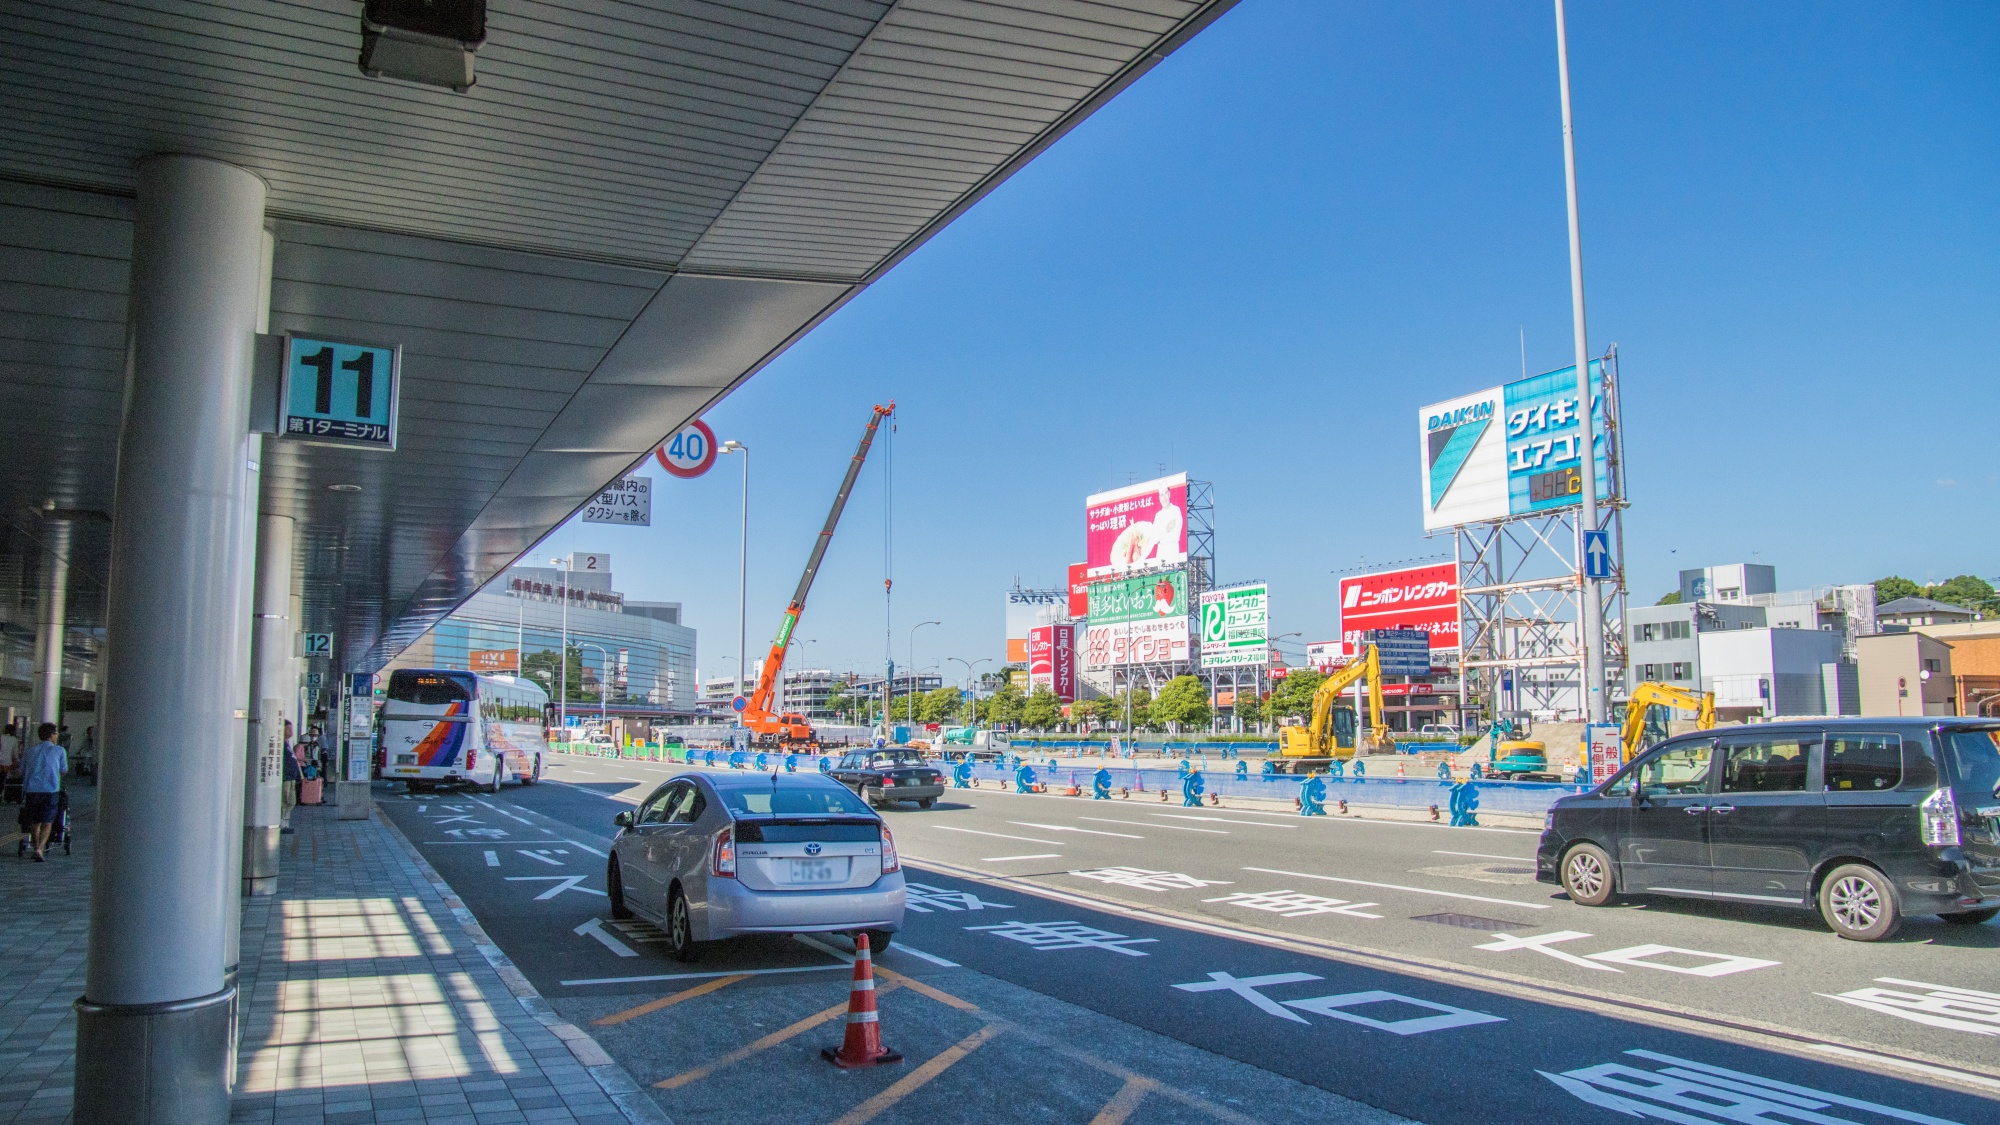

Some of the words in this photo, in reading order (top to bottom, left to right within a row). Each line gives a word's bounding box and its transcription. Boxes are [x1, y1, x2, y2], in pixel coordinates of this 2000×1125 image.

[300, 346, 374, 419] 11
[1428, 400, 1494, 431] DAIKIN
[288, 418, 387, 440] 第1ターミナル
[669, 432, 703, 461] 40
[587, 506, 646, 522] タクシーを除く
[587, 556, 597, 570] 2
[1201, 593, 1225, 604] TOYOTA
[1360, 581, 1459, 607] ニッポンレンタカー
[1227, 597, 1266, 611] レンタカー
[1228, 611, 1266, 625] カーリース
[1031, 631, 1041, 642] 日産
[1228, 627, 1266, 640] 福岡空港店
[306, 634, 329, 652] 12
[1031, 641, 1052, 652] レンタカー
[1113, 635, 1186, 663] ダイショー
[1202, 642, 1226, 650] レンタリース
[1060, 628, 1069, 694] 日産レンタカー
[1203, 653, 1266, 665] トヨタレンタリース福岡
[307, 673, 321, 685] 13
[1605, 733, 1618, 776] 一般車
